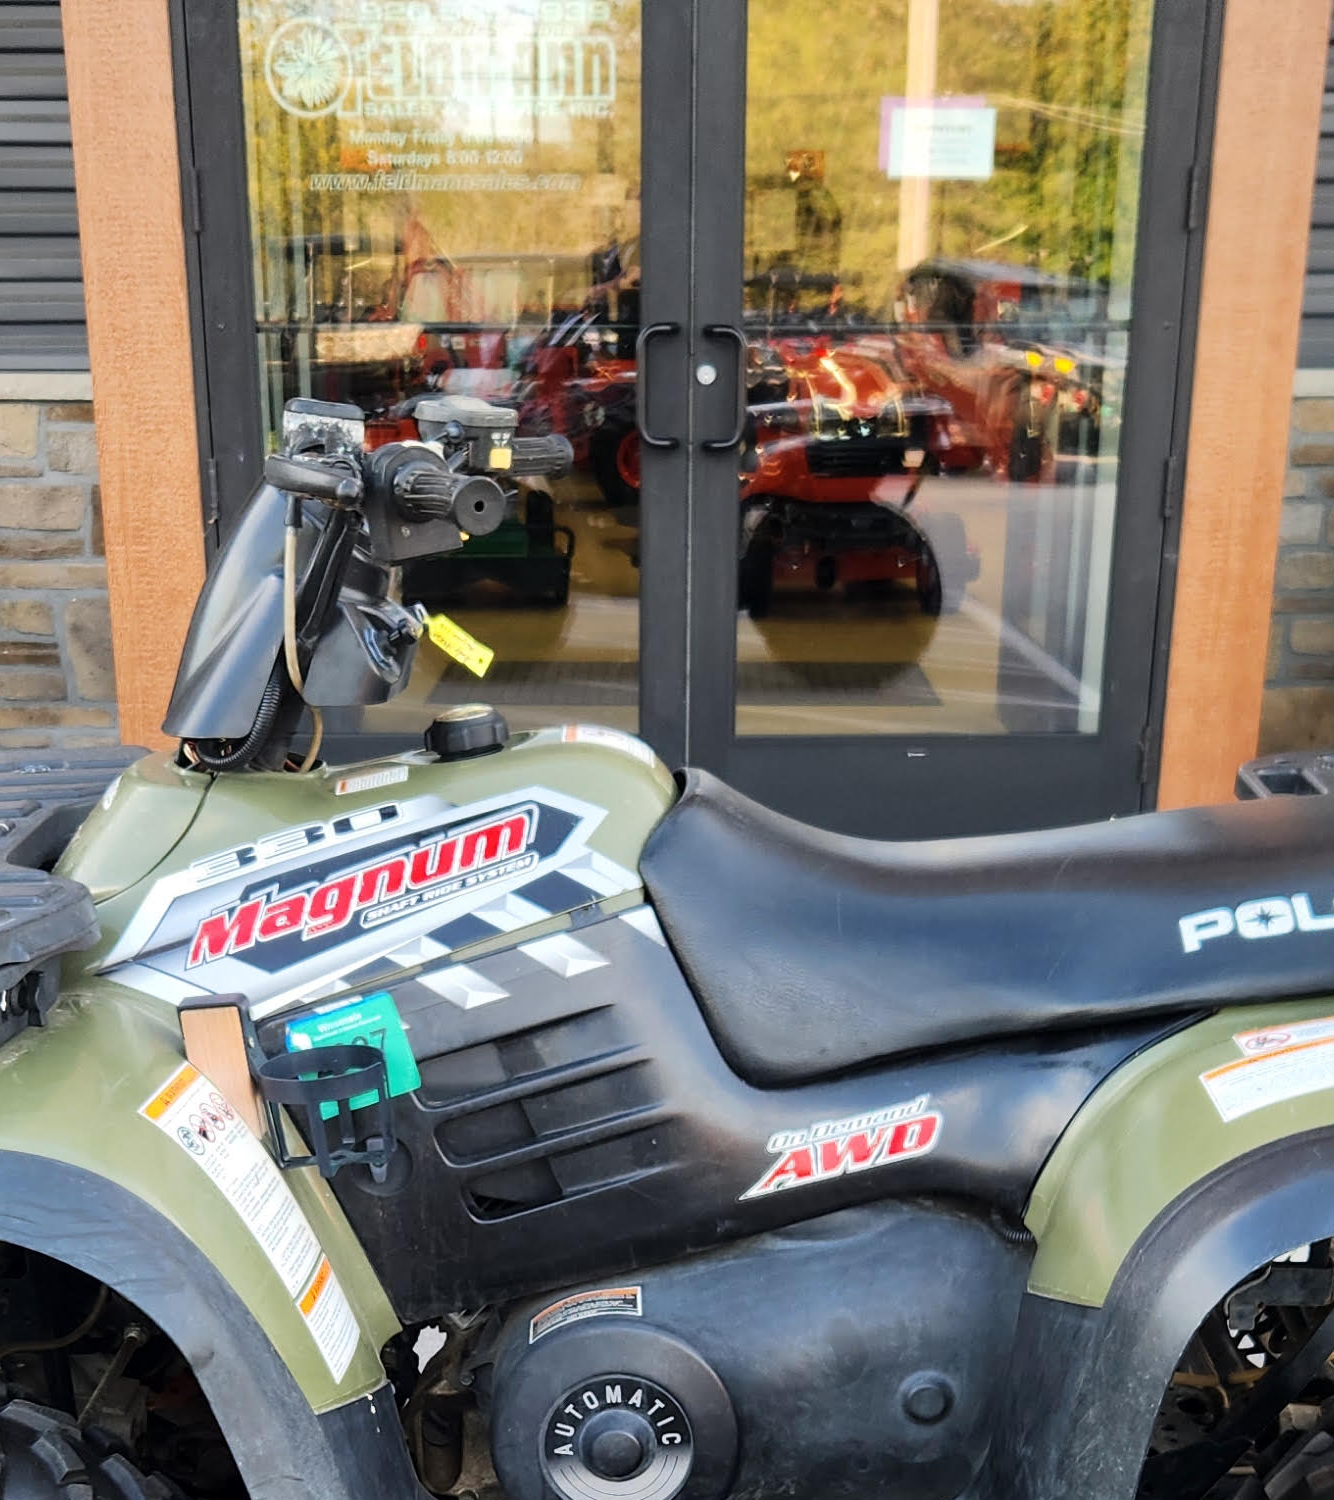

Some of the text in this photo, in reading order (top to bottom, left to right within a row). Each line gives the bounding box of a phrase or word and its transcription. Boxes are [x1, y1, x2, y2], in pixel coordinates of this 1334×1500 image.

[363, 101, 434, 117] SALES
[367, 150, 441, 168] Saturdays
[189, 802, 404, 884] 330
[186, 806, 535, 969] Magnum
[365, 856, 534, 922] SHAFT RIDE SYSTEM
[741, 1114, 940, 1199] AWD
[768, 1094, 930, 1153] On Demand
[553, 1384, 683, 1457] AUTOMATIC
